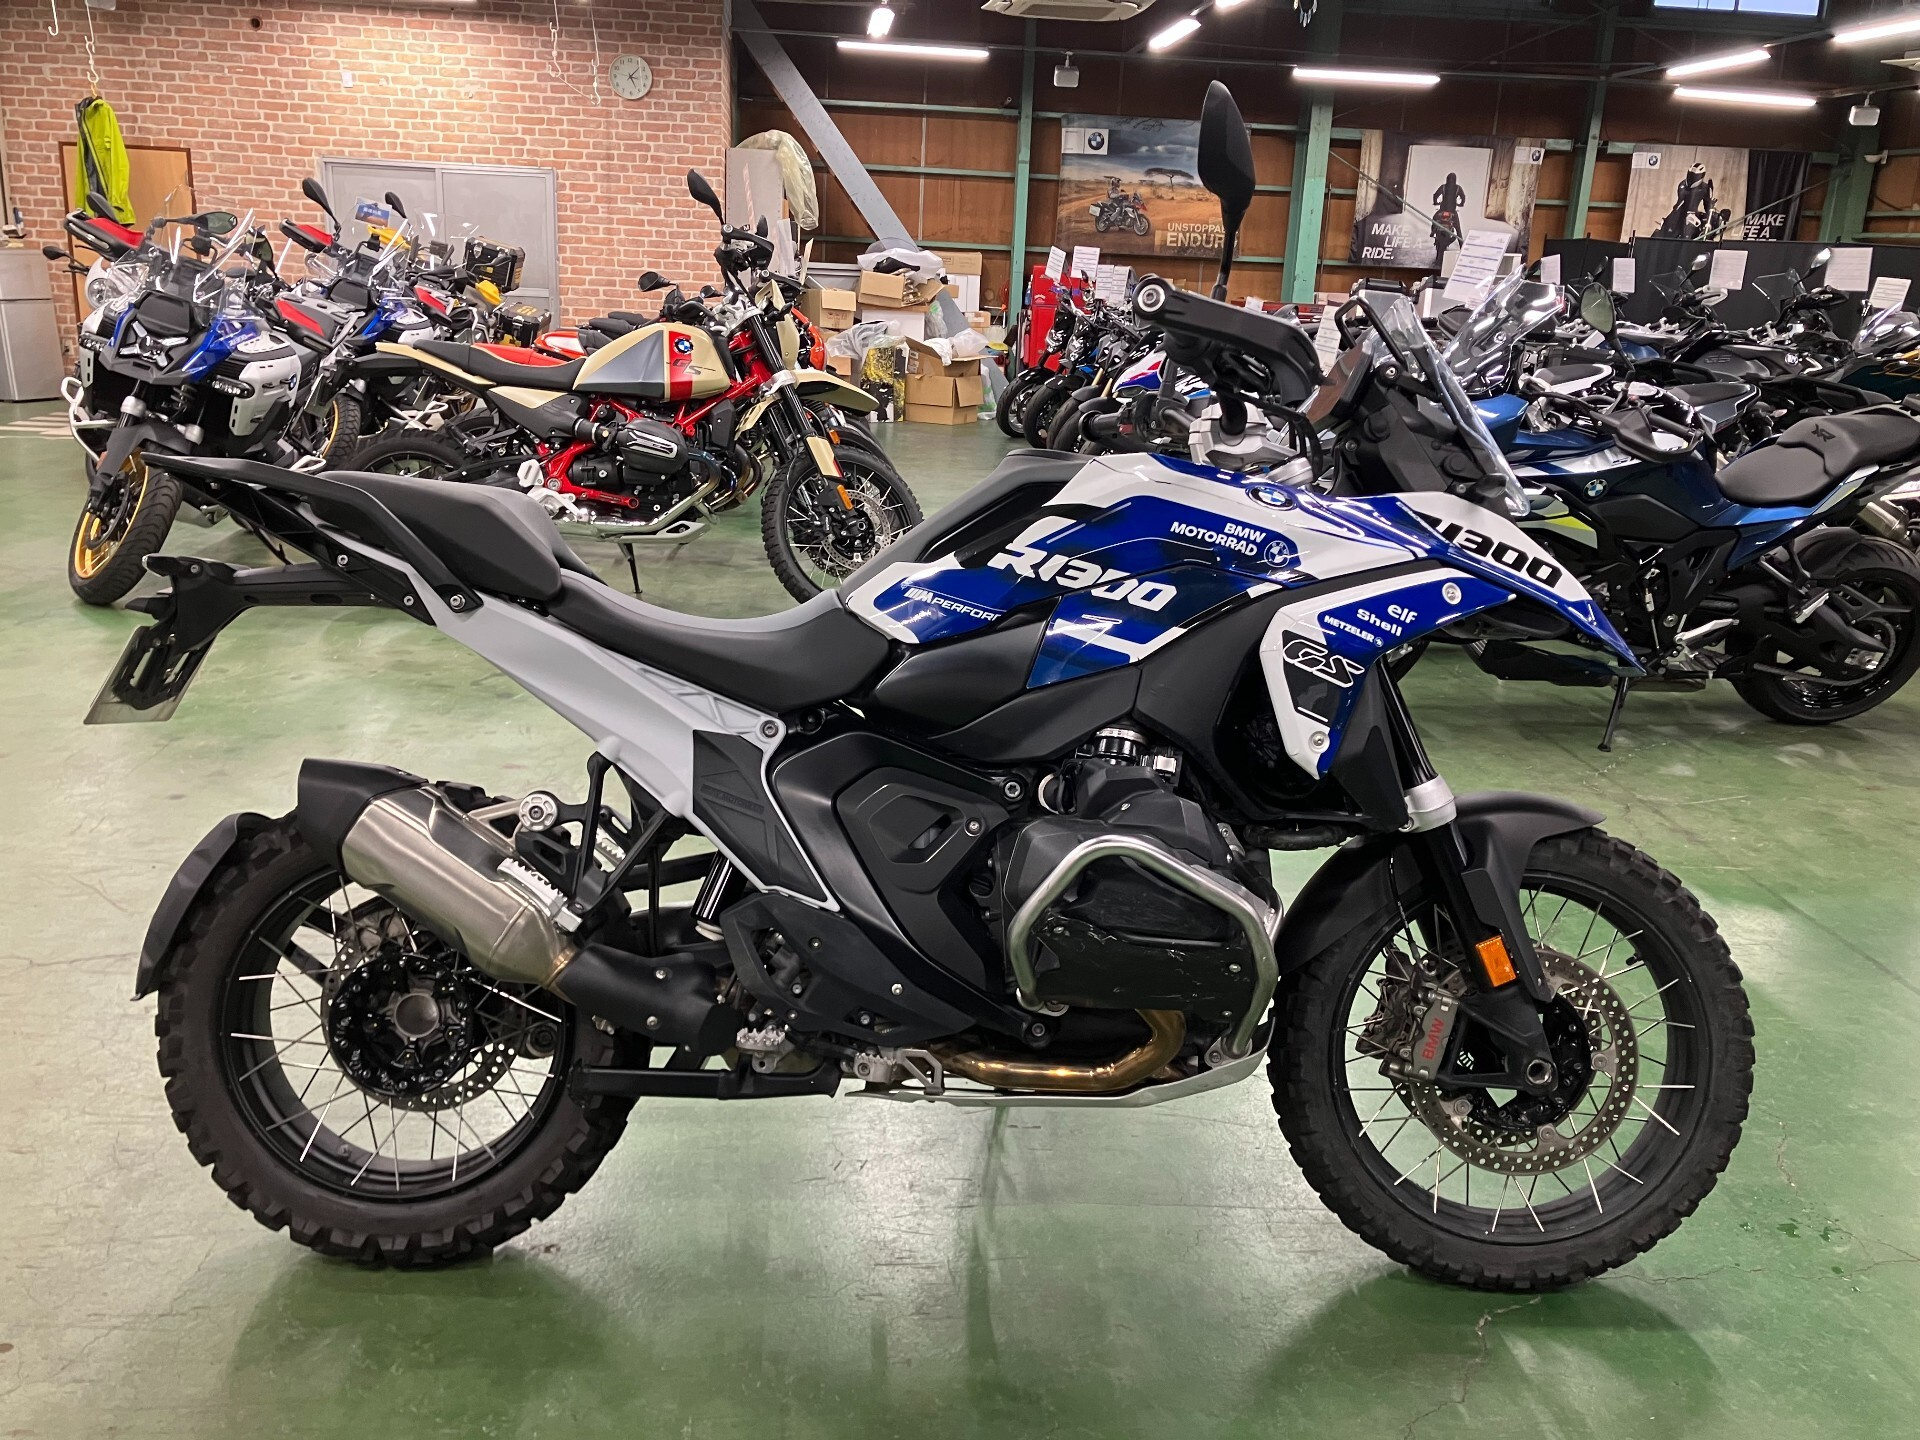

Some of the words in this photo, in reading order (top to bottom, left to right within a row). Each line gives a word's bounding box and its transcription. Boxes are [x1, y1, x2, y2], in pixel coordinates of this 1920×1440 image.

[1372, 223, 1410, 236] MAKE
[1745, 213, 1786, 226] MAKE
[1166, 232, 1236, 249] ENDUR
[1384, 236, 1412, 248] LIFE
[1362, 246, 1395, 260] RIDE.
[1170, 521, 1258, 556] MOTORRAD
[1224, 522, 1266, 543] BMW
[987, 541, 1178, 612] R1300
[1356, 608, 1403, 637] Shell
[1387, 604, 1418, 624] elf
[1324, 615, 1375, 643] METZELER
[1283, 639, 1366, 688] GS
[1421, 1017, 1446, 1061] BMW
